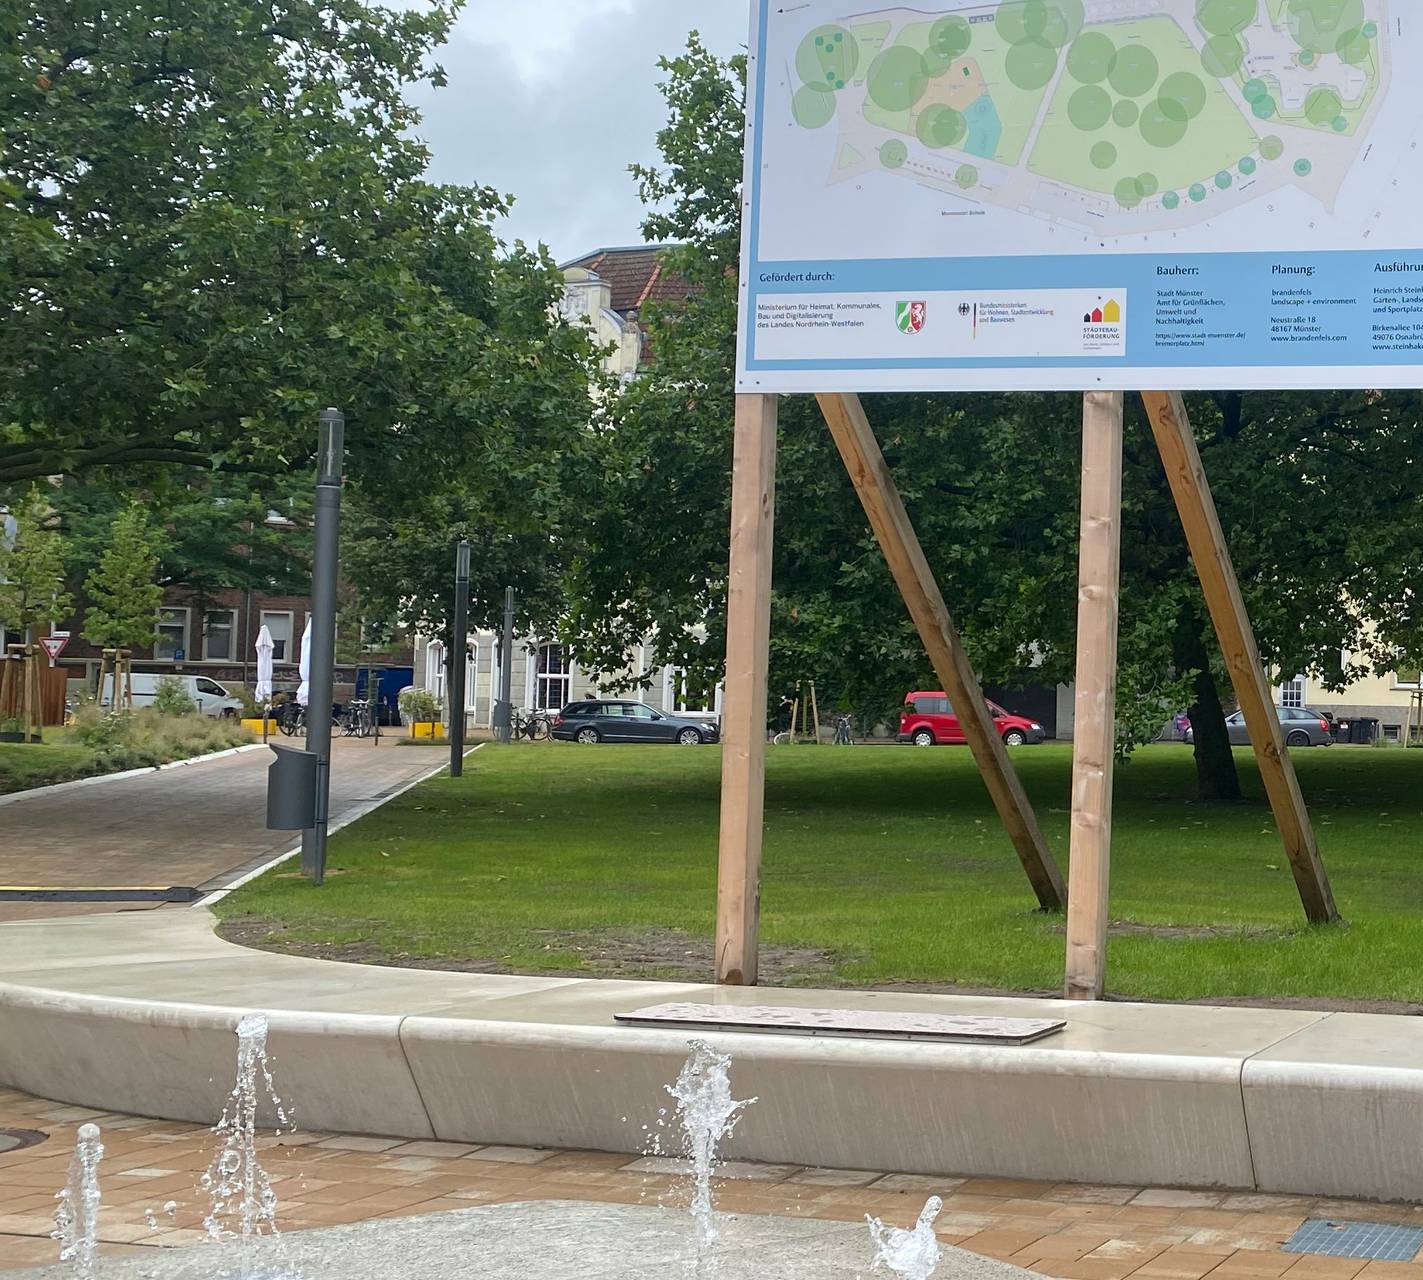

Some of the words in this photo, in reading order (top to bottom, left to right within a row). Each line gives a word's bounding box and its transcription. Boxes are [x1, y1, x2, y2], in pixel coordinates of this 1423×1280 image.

[1157, 265, 1199, 275] Bauherr:
[1272, 264, 1315, 276] Planung:
[760, 272, 803, 282] Gefördert
[806, 272, 835, 281] durch:
[1271, 288, 1312, 296] brandenfels
[837, 302, 881, 310] Kommunales,
[1271, 298, 1304, 307] landscape
[786, 312, 833, 321] Digitalisierung
[1271, 316, 1306, 324] Neustraße
[1156, 318, 1204, 326] Nachhaltigkeit
